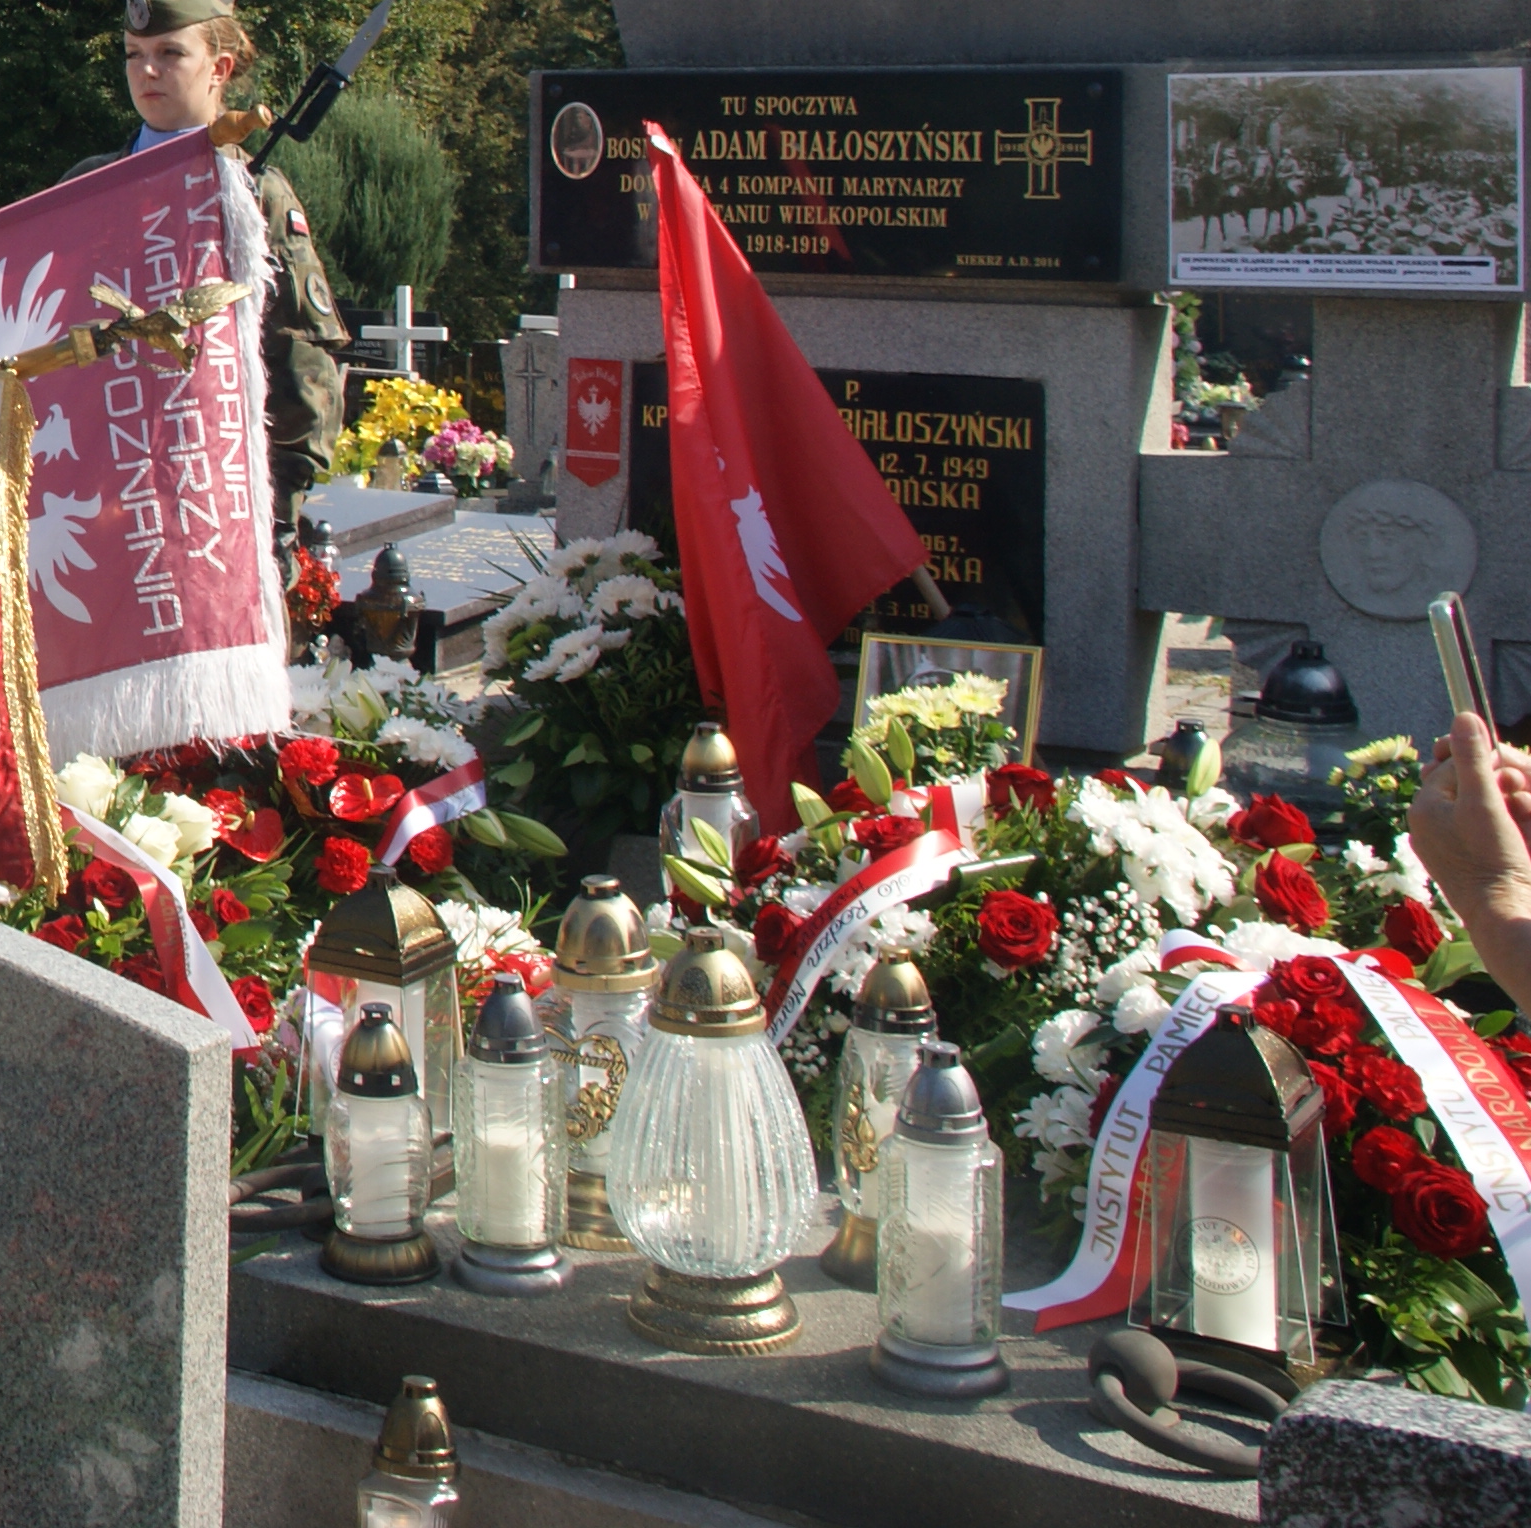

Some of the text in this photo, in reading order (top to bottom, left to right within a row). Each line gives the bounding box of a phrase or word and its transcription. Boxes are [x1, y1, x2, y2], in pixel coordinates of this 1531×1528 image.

[720, 96, 858, 116] TU SPOCZYWA
[691, 129, 767, 161] ADAM
[779, 123, 983, 162] BIAŁOSZYŃSKI
[719, 176, 729, 194] 4
[738, 175, 834, 197] KOMPANII
[843, 178, 965, 198] MARYNARZY
[637, 202, 651, 221] W
[779, 204, 948, 228] WIELKOPOLSKIM
[746, 234, 830, 254] 1918-1919
[956, 254, 1003, 267] KIEKRZ
[1034, 256, 1061, 268] 2014
[642, 405, 668, 428] KP
[943, 456, 989, 479] 1949
[885, 476, 980, 510] AŃSKA
